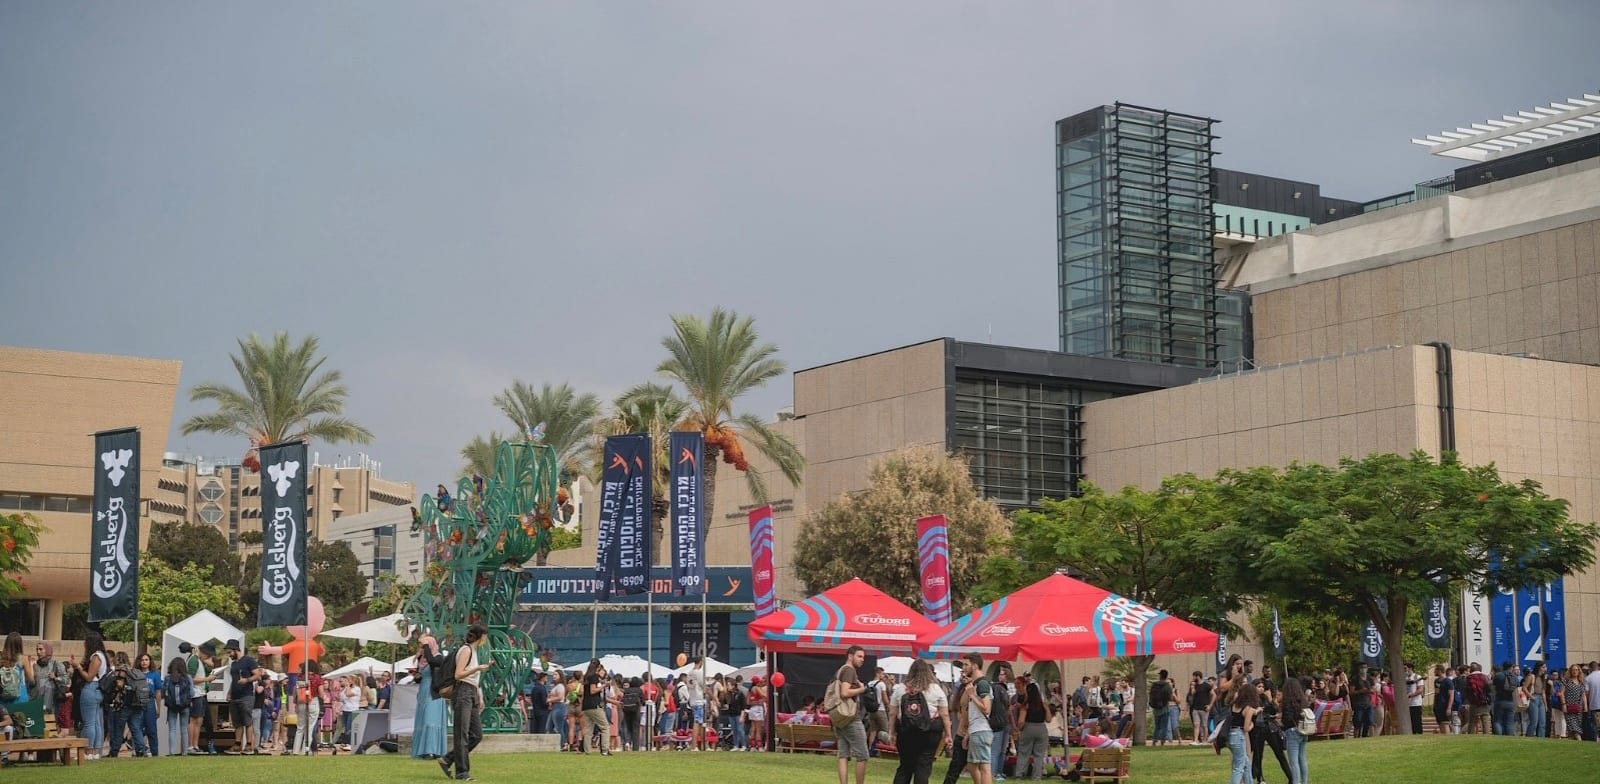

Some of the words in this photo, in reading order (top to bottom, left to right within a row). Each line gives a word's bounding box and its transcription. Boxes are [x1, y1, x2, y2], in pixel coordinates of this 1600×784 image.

[635, 476, 643, 528] באוניברסיטת
[677, 476, 689, 508] מרכז
[93, 496, 131, 599] Carlsberg
[262, 506, 300, 606] Carlsberg
[620, 516, 634, 568] הספורט
[635, 531, 643, 567] תל-אביב
[678, 515, 688, 568] הספורט
[857, 614, 910, 626] TUBORG
[1102, 597, 1131, 625] FOR
[1121, 604, 1159, 636] FUN
[1043, 624, 1089, 635] TUBORG
